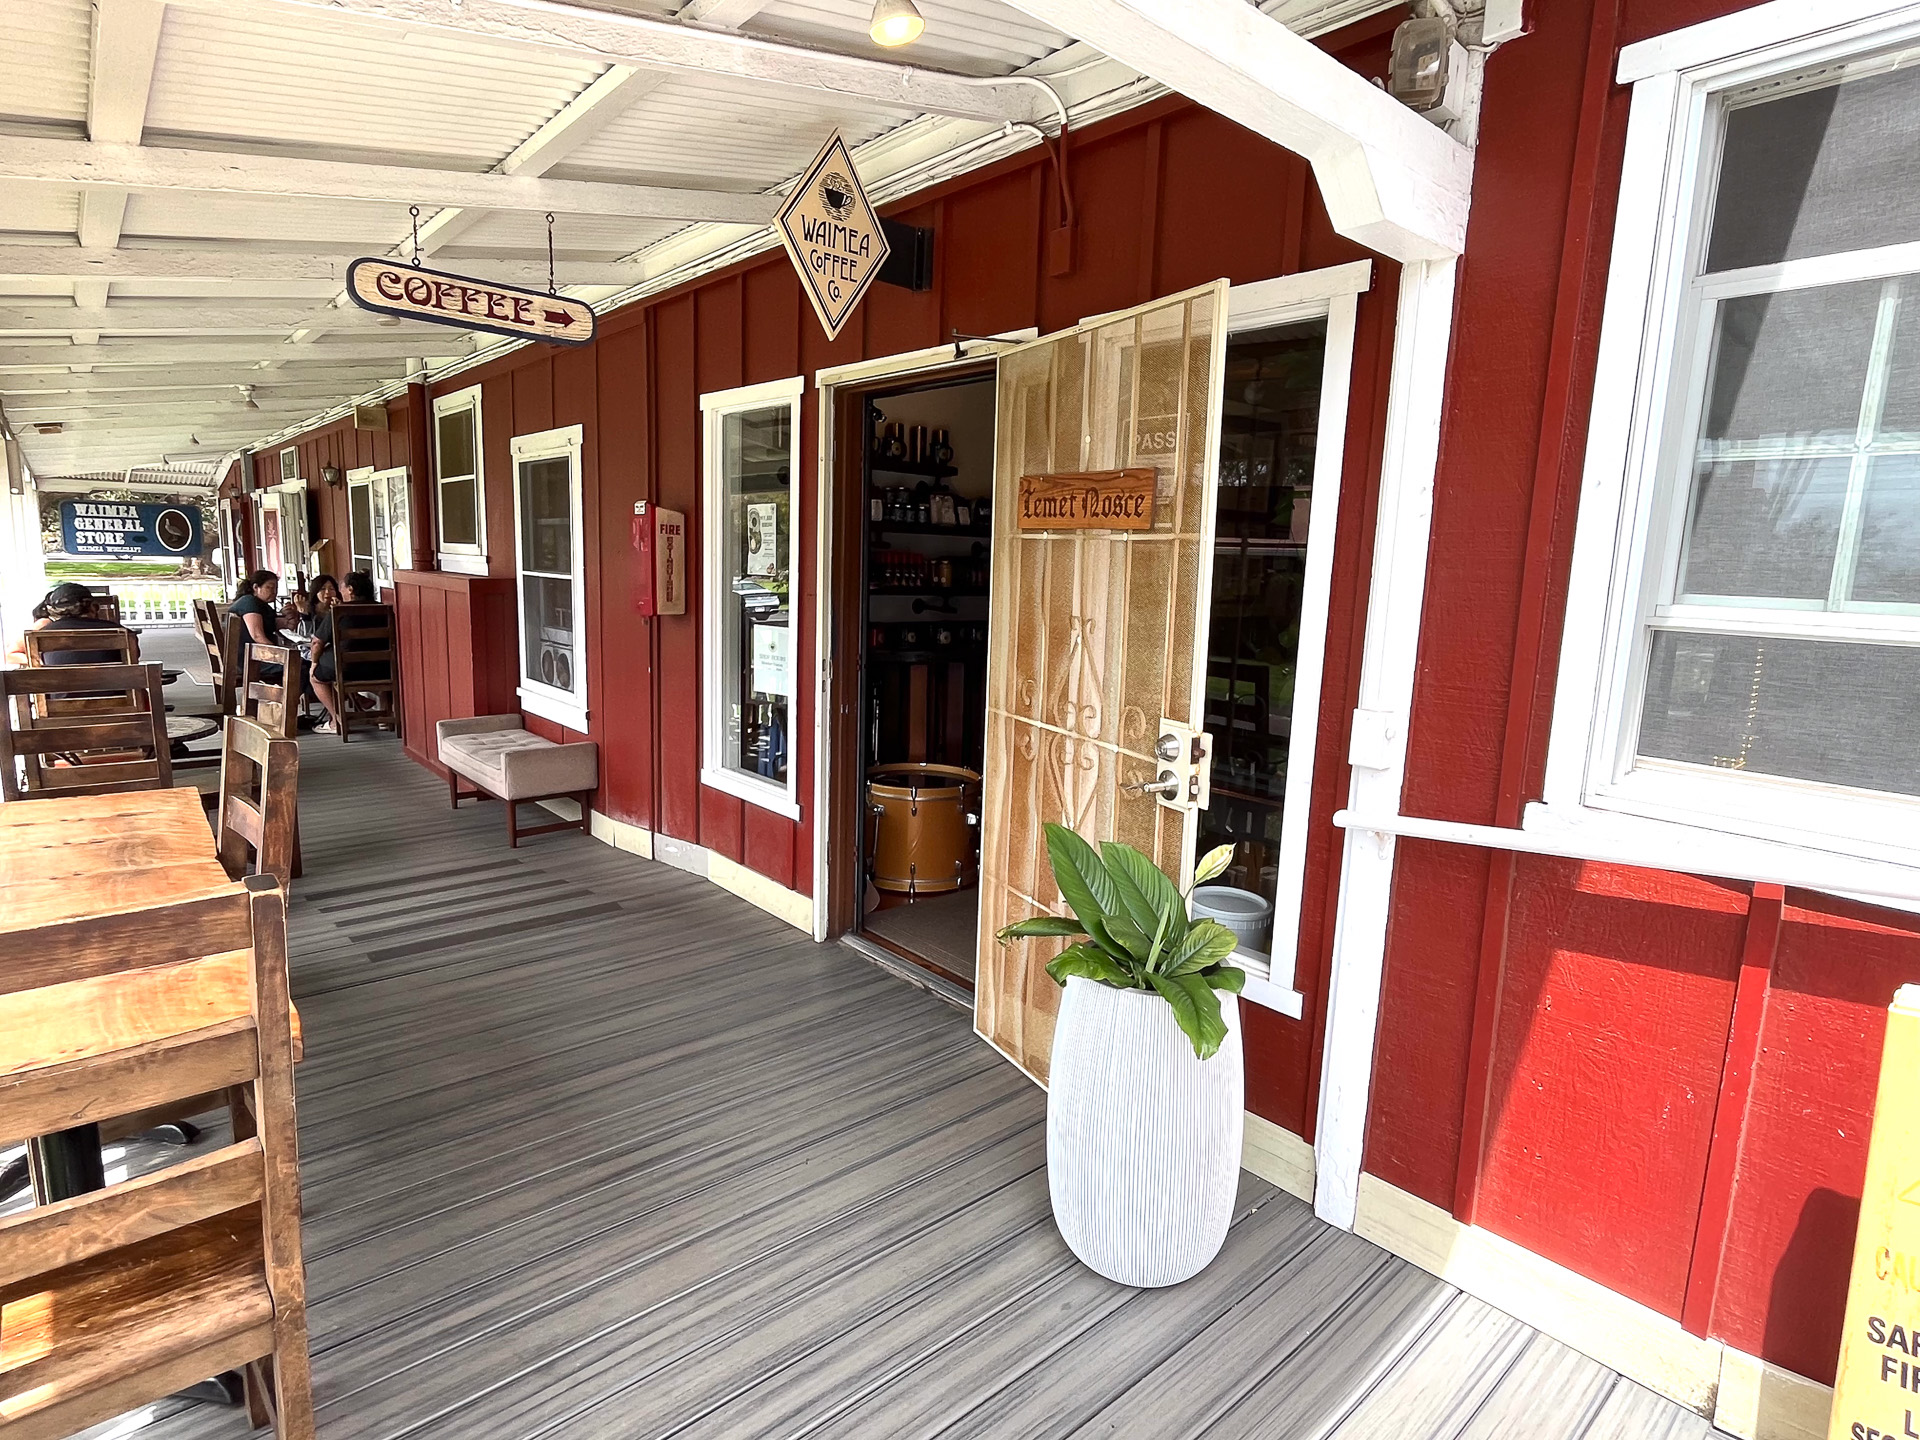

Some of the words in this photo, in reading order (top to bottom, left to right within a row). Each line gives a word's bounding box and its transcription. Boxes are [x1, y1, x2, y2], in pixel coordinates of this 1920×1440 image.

[801, 214, 870, 259] WAIMEA
[809, 248, 858, 283] COFFEE
[376, 271, 535, 326] COFFEE
[72, 503, 139, 518] WAIMEA
[73, 517, 145, 532] GENERAL
[659, 524, 681, 536] FIRE
[75, 531, 126, 545] STORE
